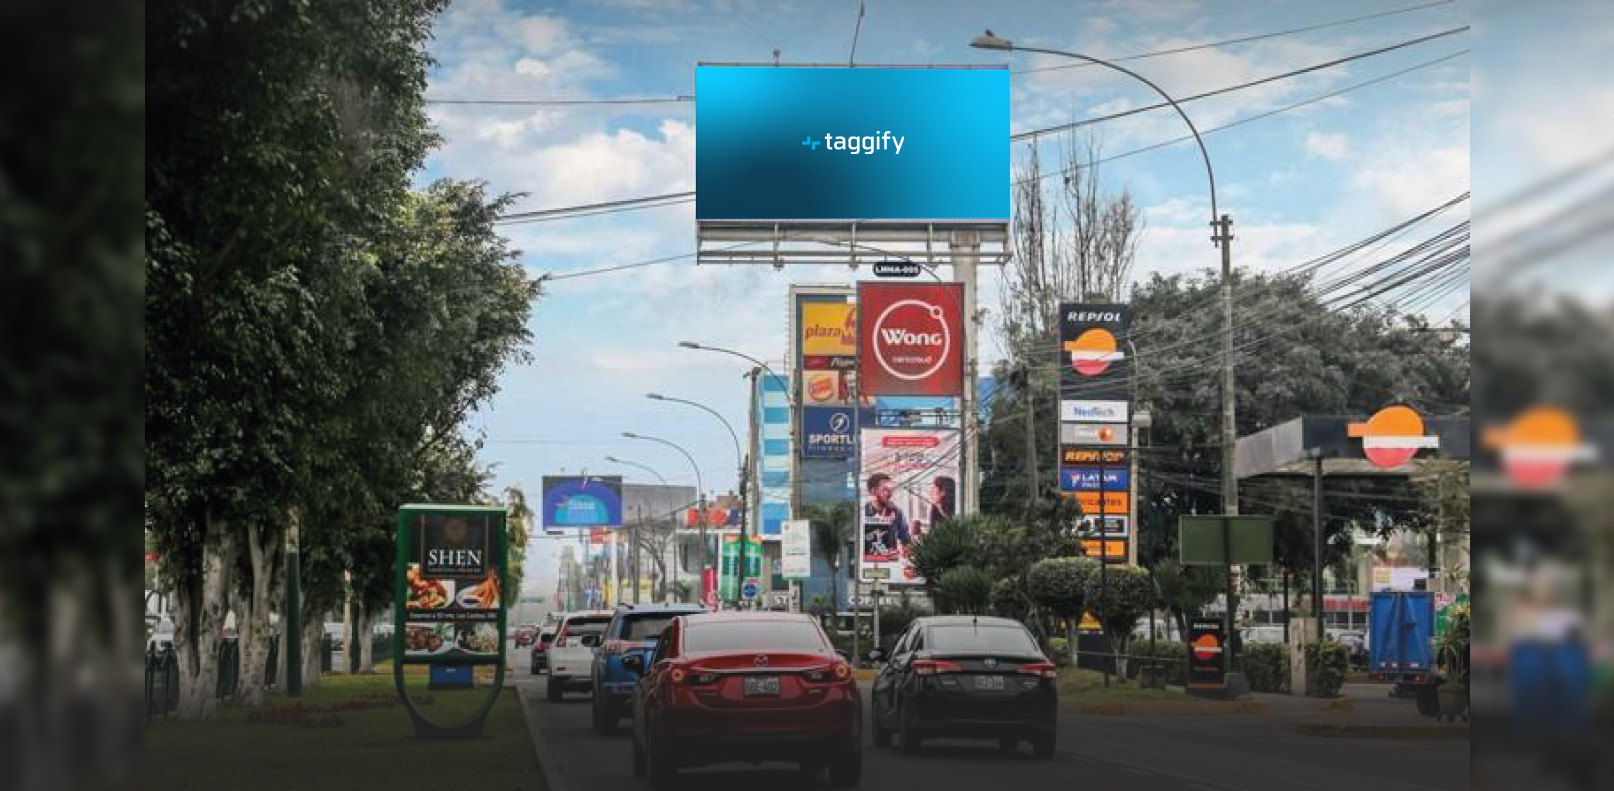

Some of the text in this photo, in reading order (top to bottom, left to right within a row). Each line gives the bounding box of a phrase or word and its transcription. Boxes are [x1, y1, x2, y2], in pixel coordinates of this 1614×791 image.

[824, 130, 905, 155] taggify
[1067, 311, 1121, 322] REPSOL
[428, 549, 482, 566] SHEN
